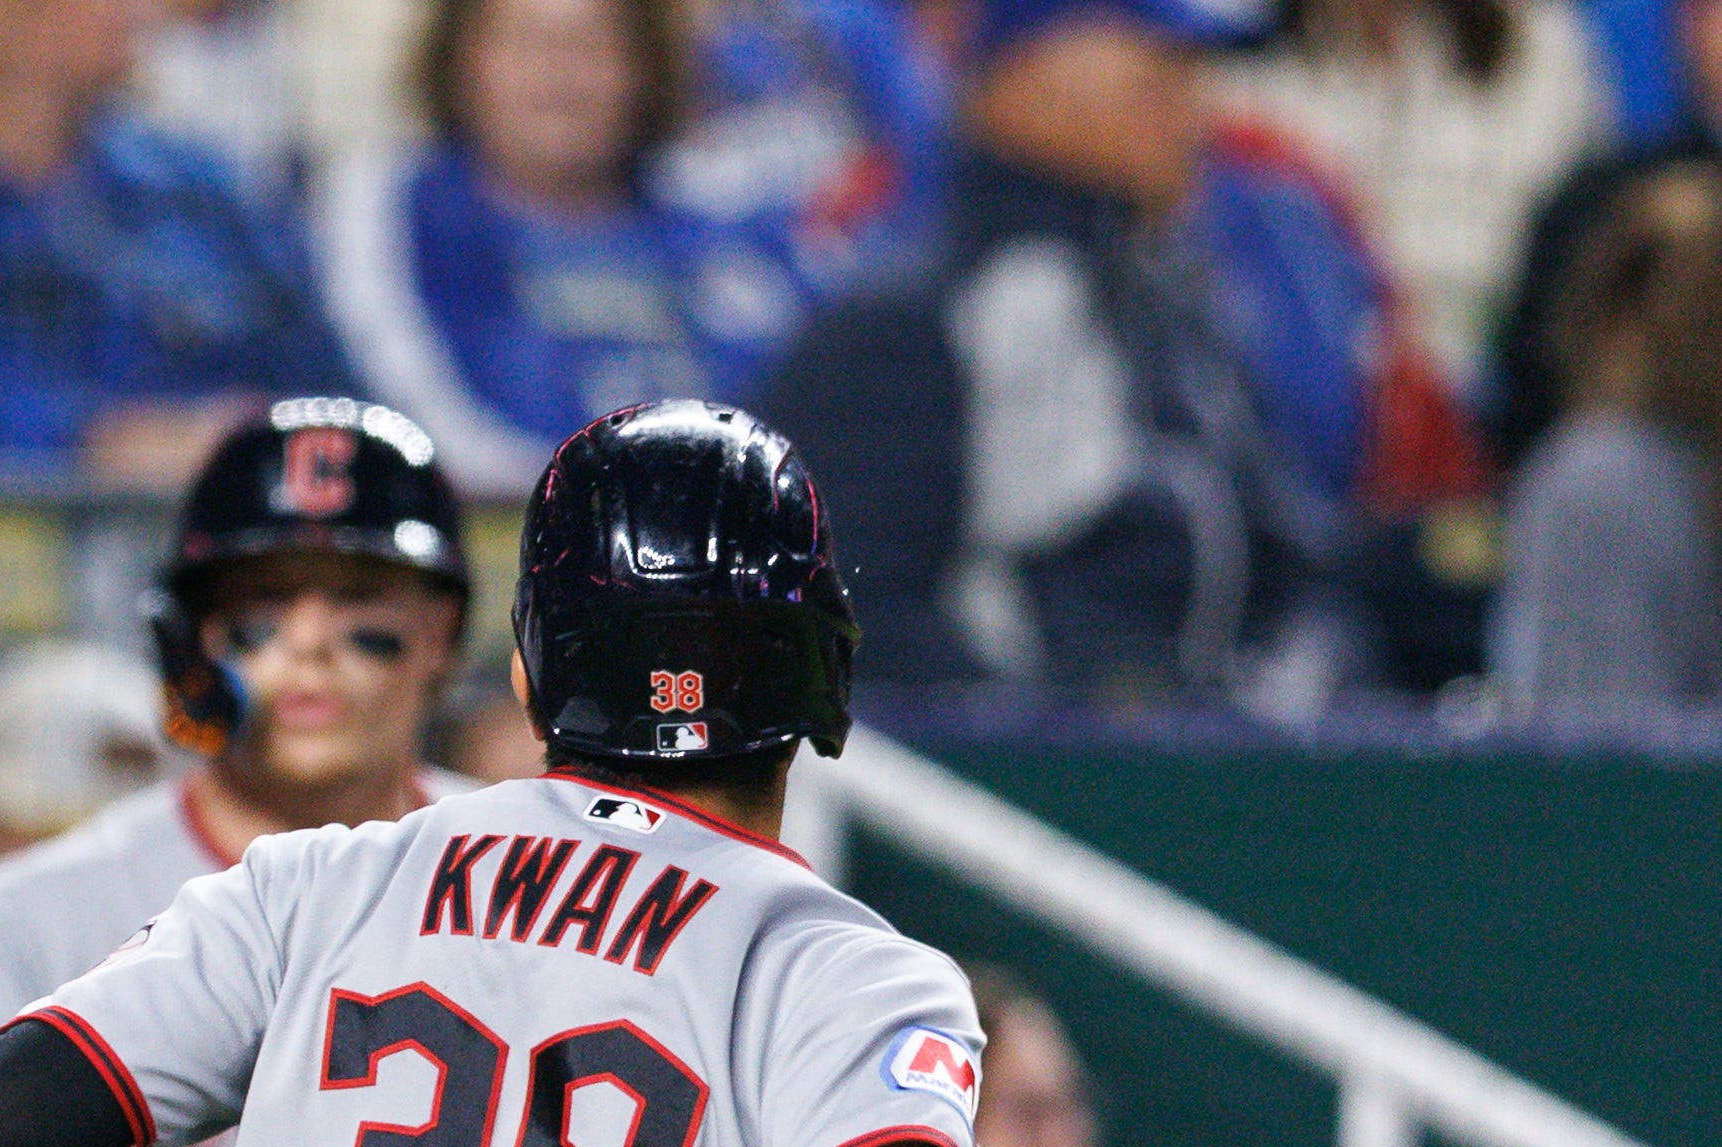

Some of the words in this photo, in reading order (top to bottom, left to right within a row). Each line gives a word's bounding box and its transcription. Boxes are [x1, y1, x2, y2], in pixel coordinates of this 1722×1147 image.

[284, 426, 356, 514] C
[649, 668, 704, 714] 38
[419, 833, 719, 977] KWAN
